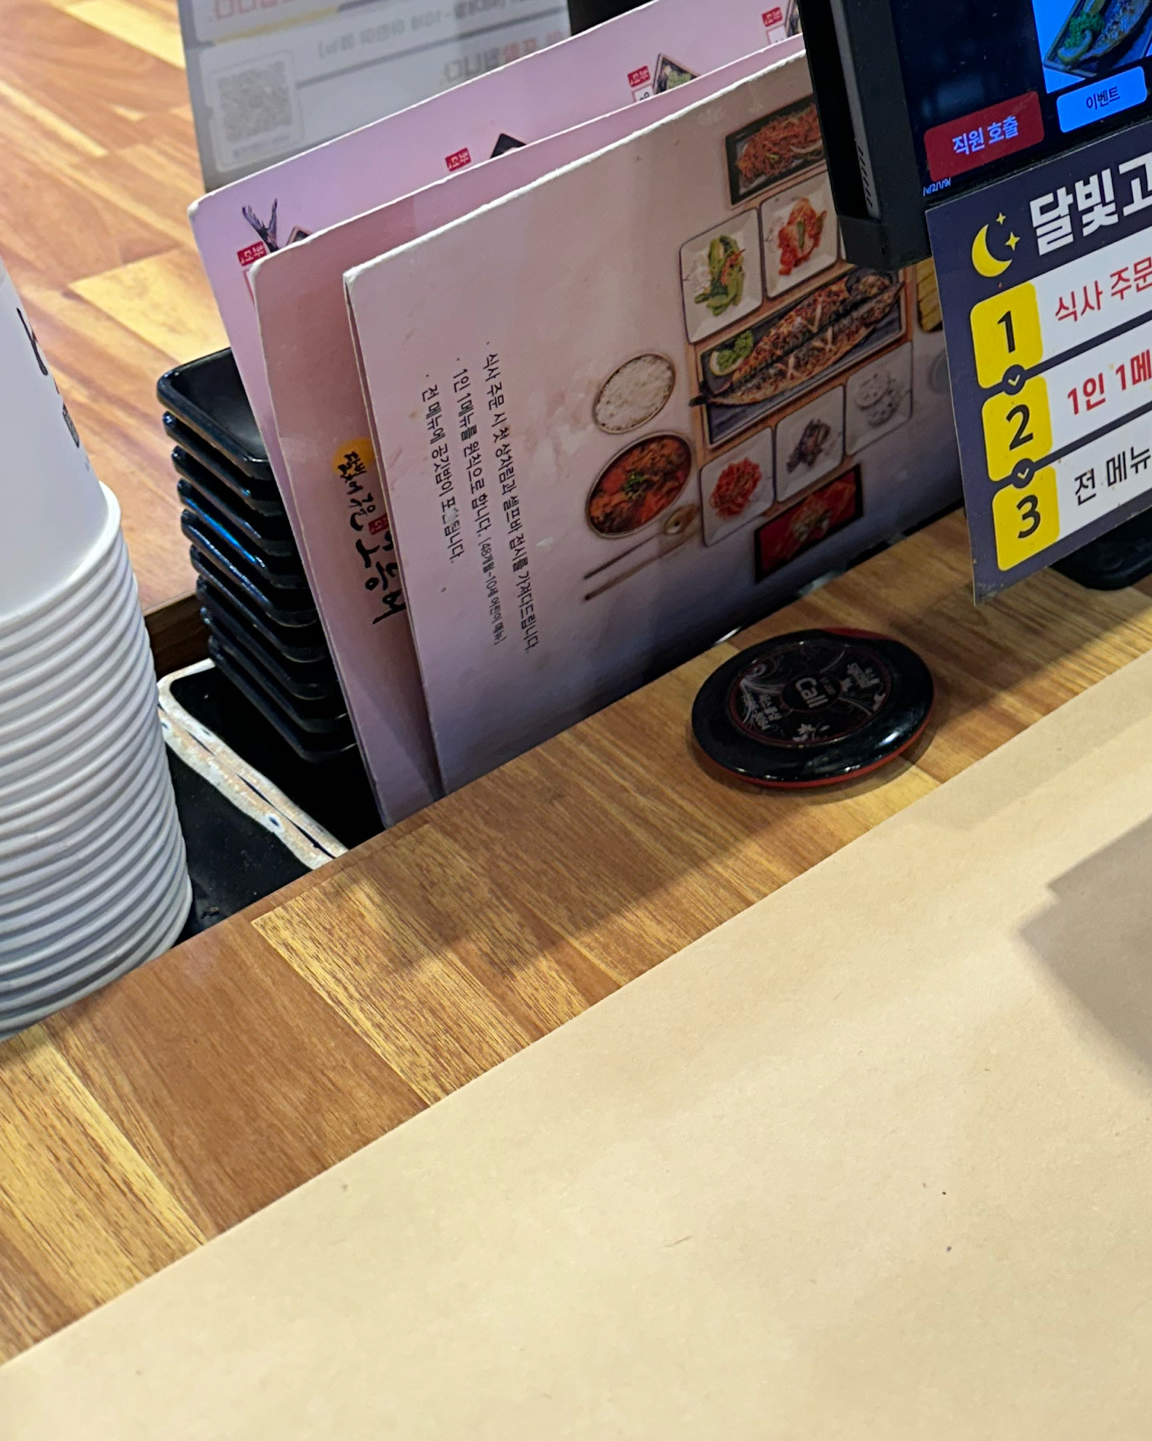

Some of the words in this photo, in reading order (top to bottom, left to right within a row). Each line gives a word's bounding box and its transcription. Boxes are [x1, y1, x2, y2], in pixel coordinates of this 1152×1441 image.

[1085, 86, 1120, 110] 이벤트
[952, 127, 985, 156] 직원
[987, 115, 1019, 144] 호출
[1054, 281, 1103, 323] 식사
[996, 310, 1017, 354] 1
[453, 368, 472, 393] 1인
[483, 353, 501, 382] 식사
[422, 384, 439, 402] 전
[486, 382, 505, 411] 주문
[1067, 372, 1107, 416] 1인
[425, 401, 446, 445] 메뉴에
[457, 392, 478, 442] 1메뉴를
[491, 412, 507, 428] 시
[493, 427, 510, 444] 첫
[1005, 403, 1034, 452] 2
[431, 443, 455, 498] 공깃밥이
[463, 440, 485, 495] 원칙으로
[495, 443, 517, 495] 상차림과
[1074, 469, 1098, 507] 전
[471, 492, 492, 537] 합니다.
[503, 495, 523, 535] 셀프바
[1015, 493, 1042, 540] 3
[509, 533, 529, 572] 접시를
[795, 677, 829, 709] Call
